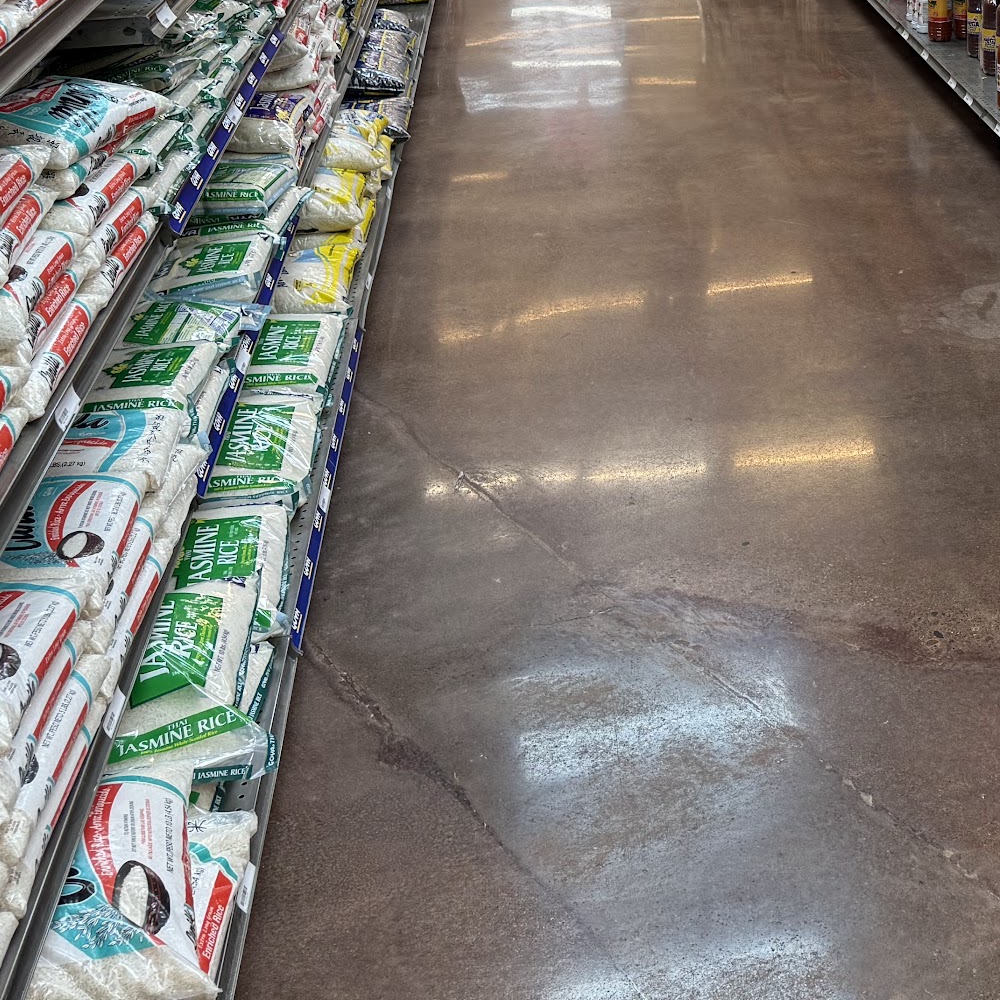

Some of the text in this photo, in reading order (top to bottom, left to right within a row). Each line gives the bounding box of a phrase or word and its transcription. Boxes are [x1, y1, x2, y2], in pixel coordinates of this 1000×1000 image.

[208, 222, 245, 233] JASMINE
[258, 324, 289, 361] JASMINE
[94, 401, 145, 412] JASMINE
[213, 412, 224, 432] GOYA
[225, 407, 258, 463] JASMINE
[314, 509, 322, 529] GOYA
[216, 540, 240, 565] RICE
[304, 556, 312, 577] GOYA
[291, 607, 301, 631] GOYA
[139, 600, 175, 683] JASMINE
[119, 710, 237, 757] JASMINE RICE
[167, 718, 189, 731] THAI
[207, 729, 219, 737] Rice
[198, 767, 246, 780] JASMINE RICE
[202, 905, 225, 960] Enriched Rice
